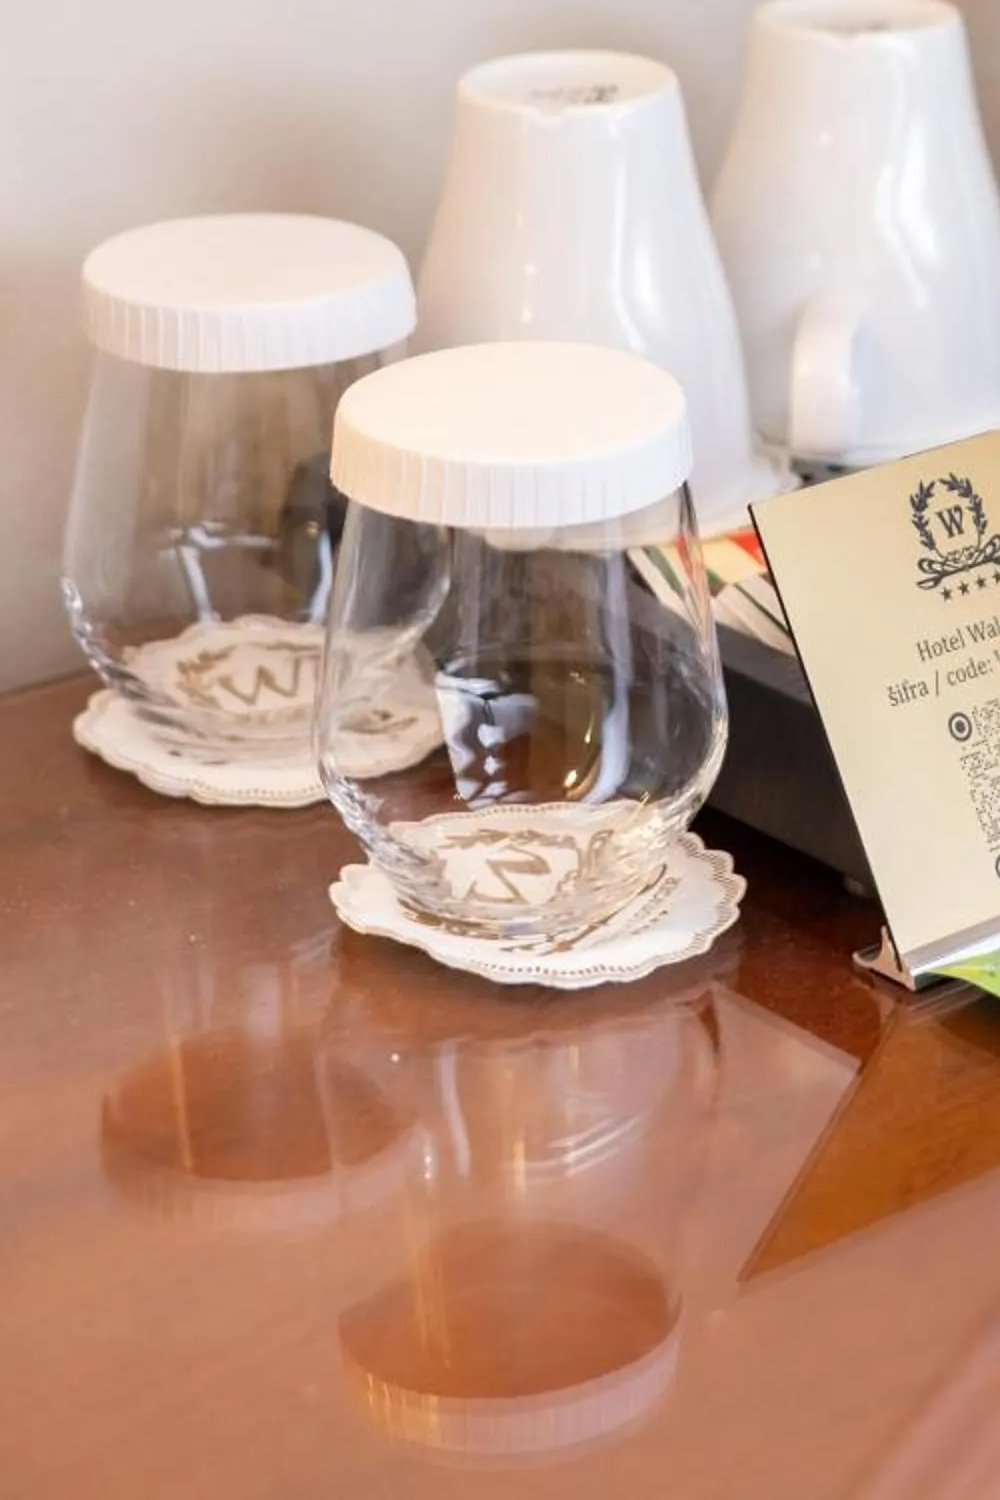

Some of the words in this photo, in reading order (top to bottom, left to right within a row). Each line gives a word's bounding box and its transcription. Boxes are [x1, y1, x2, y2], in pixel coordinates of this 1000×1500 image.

[936, 504, 964, 538] W
[916, 628, 966, 662] Hotel
[887, 678, 929, 707] šifra
[947, 657, 993, 687] code:
